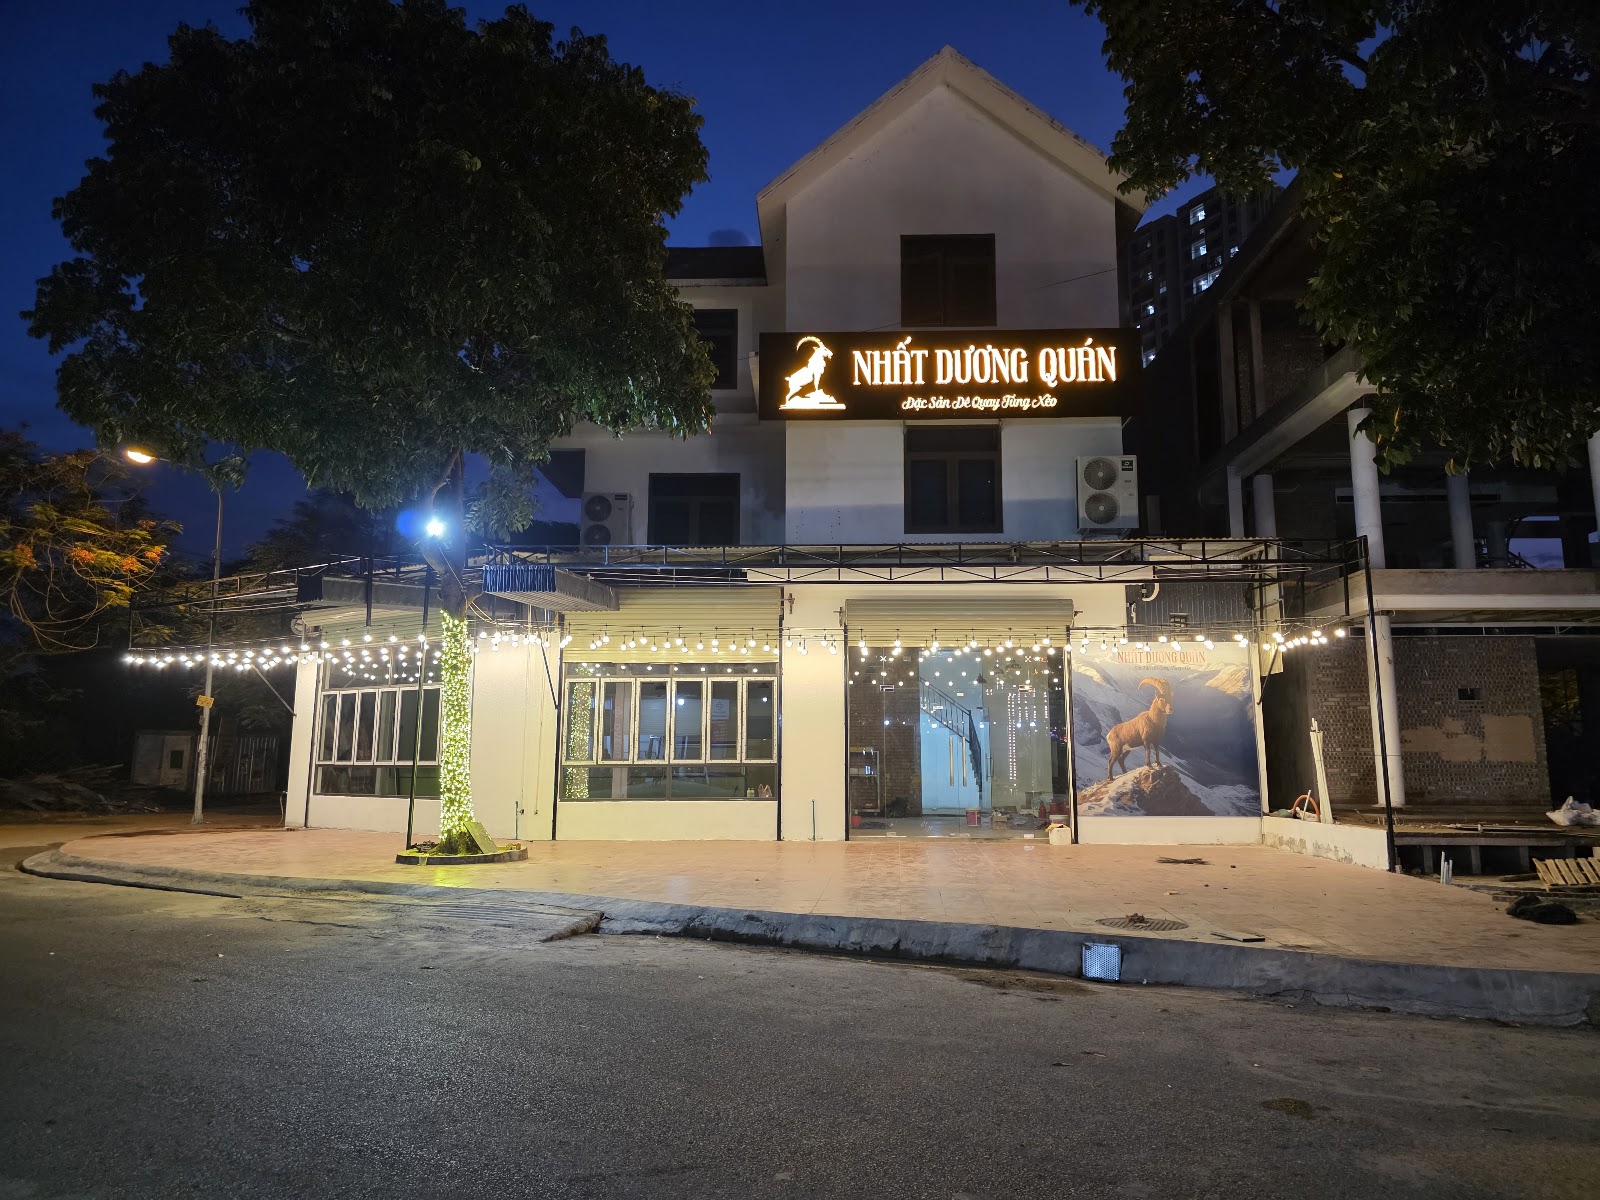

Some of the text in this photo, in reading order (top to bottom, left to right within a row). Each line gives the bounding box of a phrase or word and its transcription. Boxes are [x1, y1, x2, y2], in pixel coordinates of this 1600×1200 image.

[852, 336, 1117, 388] NHẤT DƯƠNG QUÁN
[928, 395, 951, 409] Sản
[952, 396, 971, 410] Dê
[971, 395, 1000, 412] Quay
